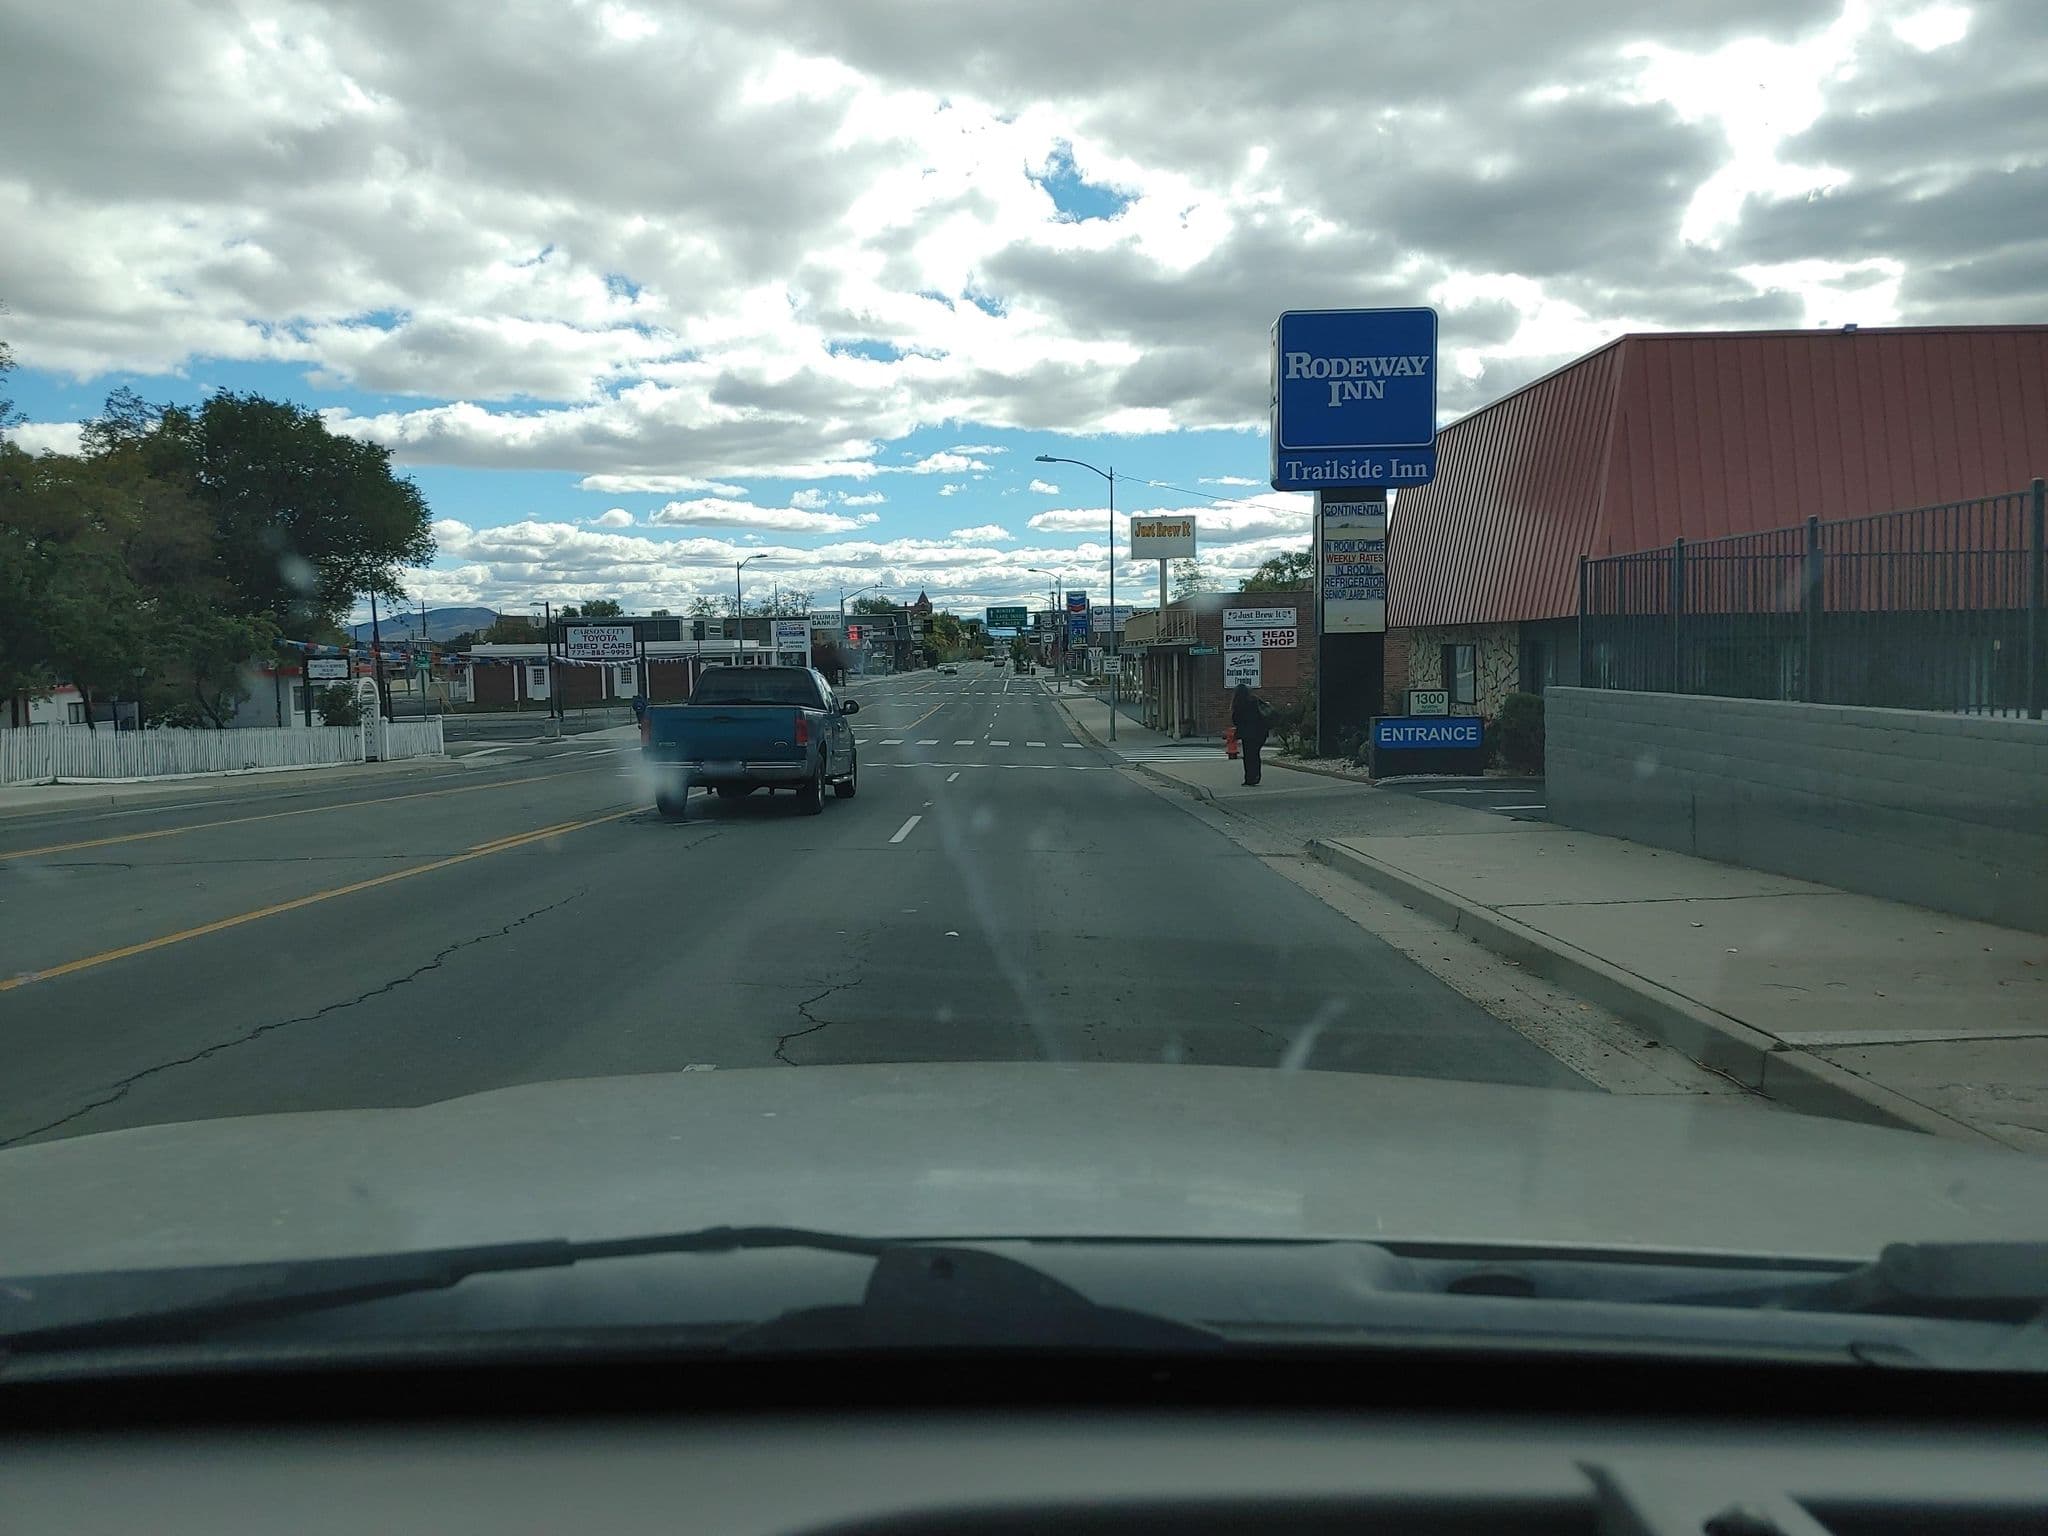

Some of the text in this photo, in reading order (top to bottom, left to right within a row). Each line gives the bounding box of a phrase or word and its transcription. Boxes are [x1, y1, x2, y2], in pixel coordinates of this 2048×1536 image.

[1285, 352, 1430, 379] RODEWAY
[1328, 380, 1386, 407] INN
[1286, 458, 1429, 480] Trailside Inn
[1325, 504, 1384, 516] CONTINENTAL
[1334, 541, 1355, 552] ROOM
[1327, 553, 1384, 563] WEEKLY RATES
[1335, 565, 1373, 575] IN ROOM
[1325, 577, 1384, 587] REFRIGERATOR
[1366, 589, 1384, 599] RATES
[1238, 610, 1281, 619] Just Brew It
[583, 634, 618, 642] TOYOTA
[1262, 630, 1295, 638] HEAD
[1262, 638, 1295, 646] SHOP
[1415, 693, 1444, 704] 1300
[1381, 727, 1477, 741] ENTRANCE
